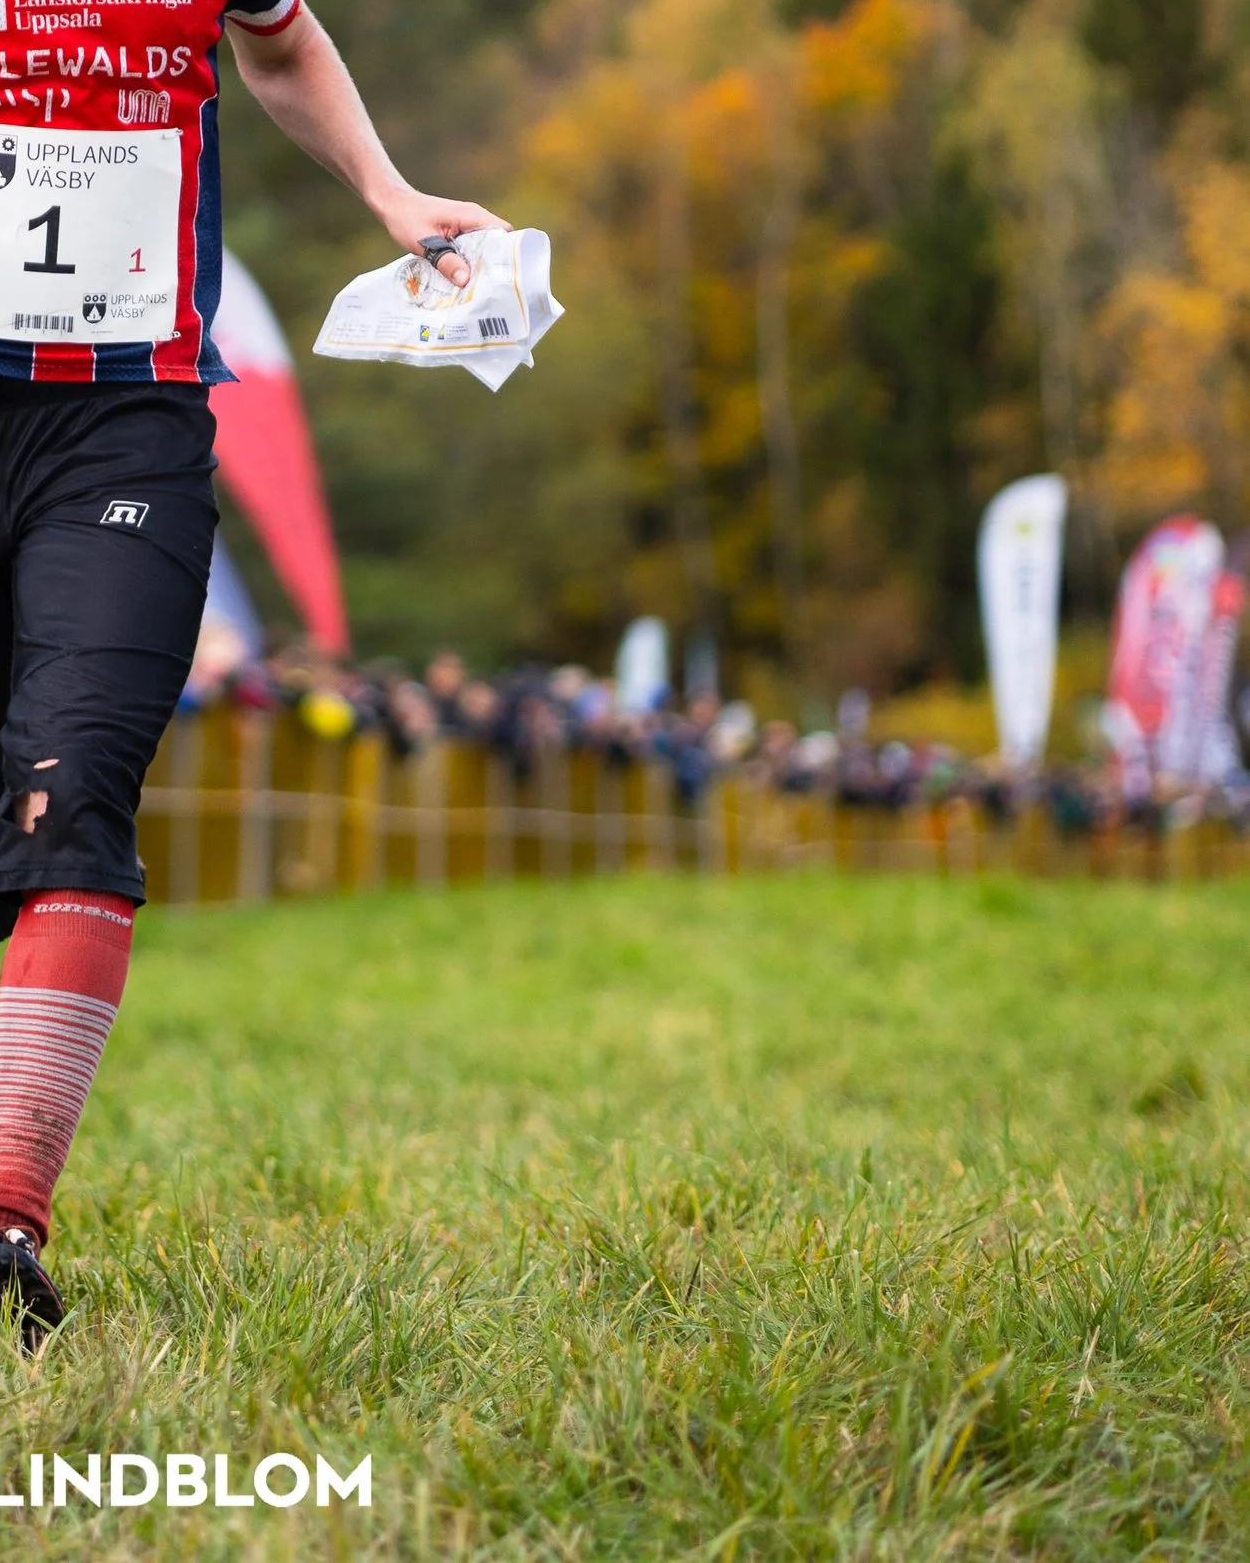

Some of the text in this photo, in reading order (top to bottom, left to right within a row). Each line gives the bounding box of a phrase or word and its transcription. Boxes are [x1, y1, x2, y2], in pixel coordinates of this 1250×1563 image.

[15, 8, 102, 35] Uppsala
[26, 142, 139, 165] UPPLANDS
[26, 165, 96, 190] VÄSBY
[23, 205, 76, 274] 1
[128, 247, 147, 273] 1
[110, 293, 168, 305] UPPLANDS
[110, 306, 146, 319] VÄSBY
[33, 902, 132, 927] noname
